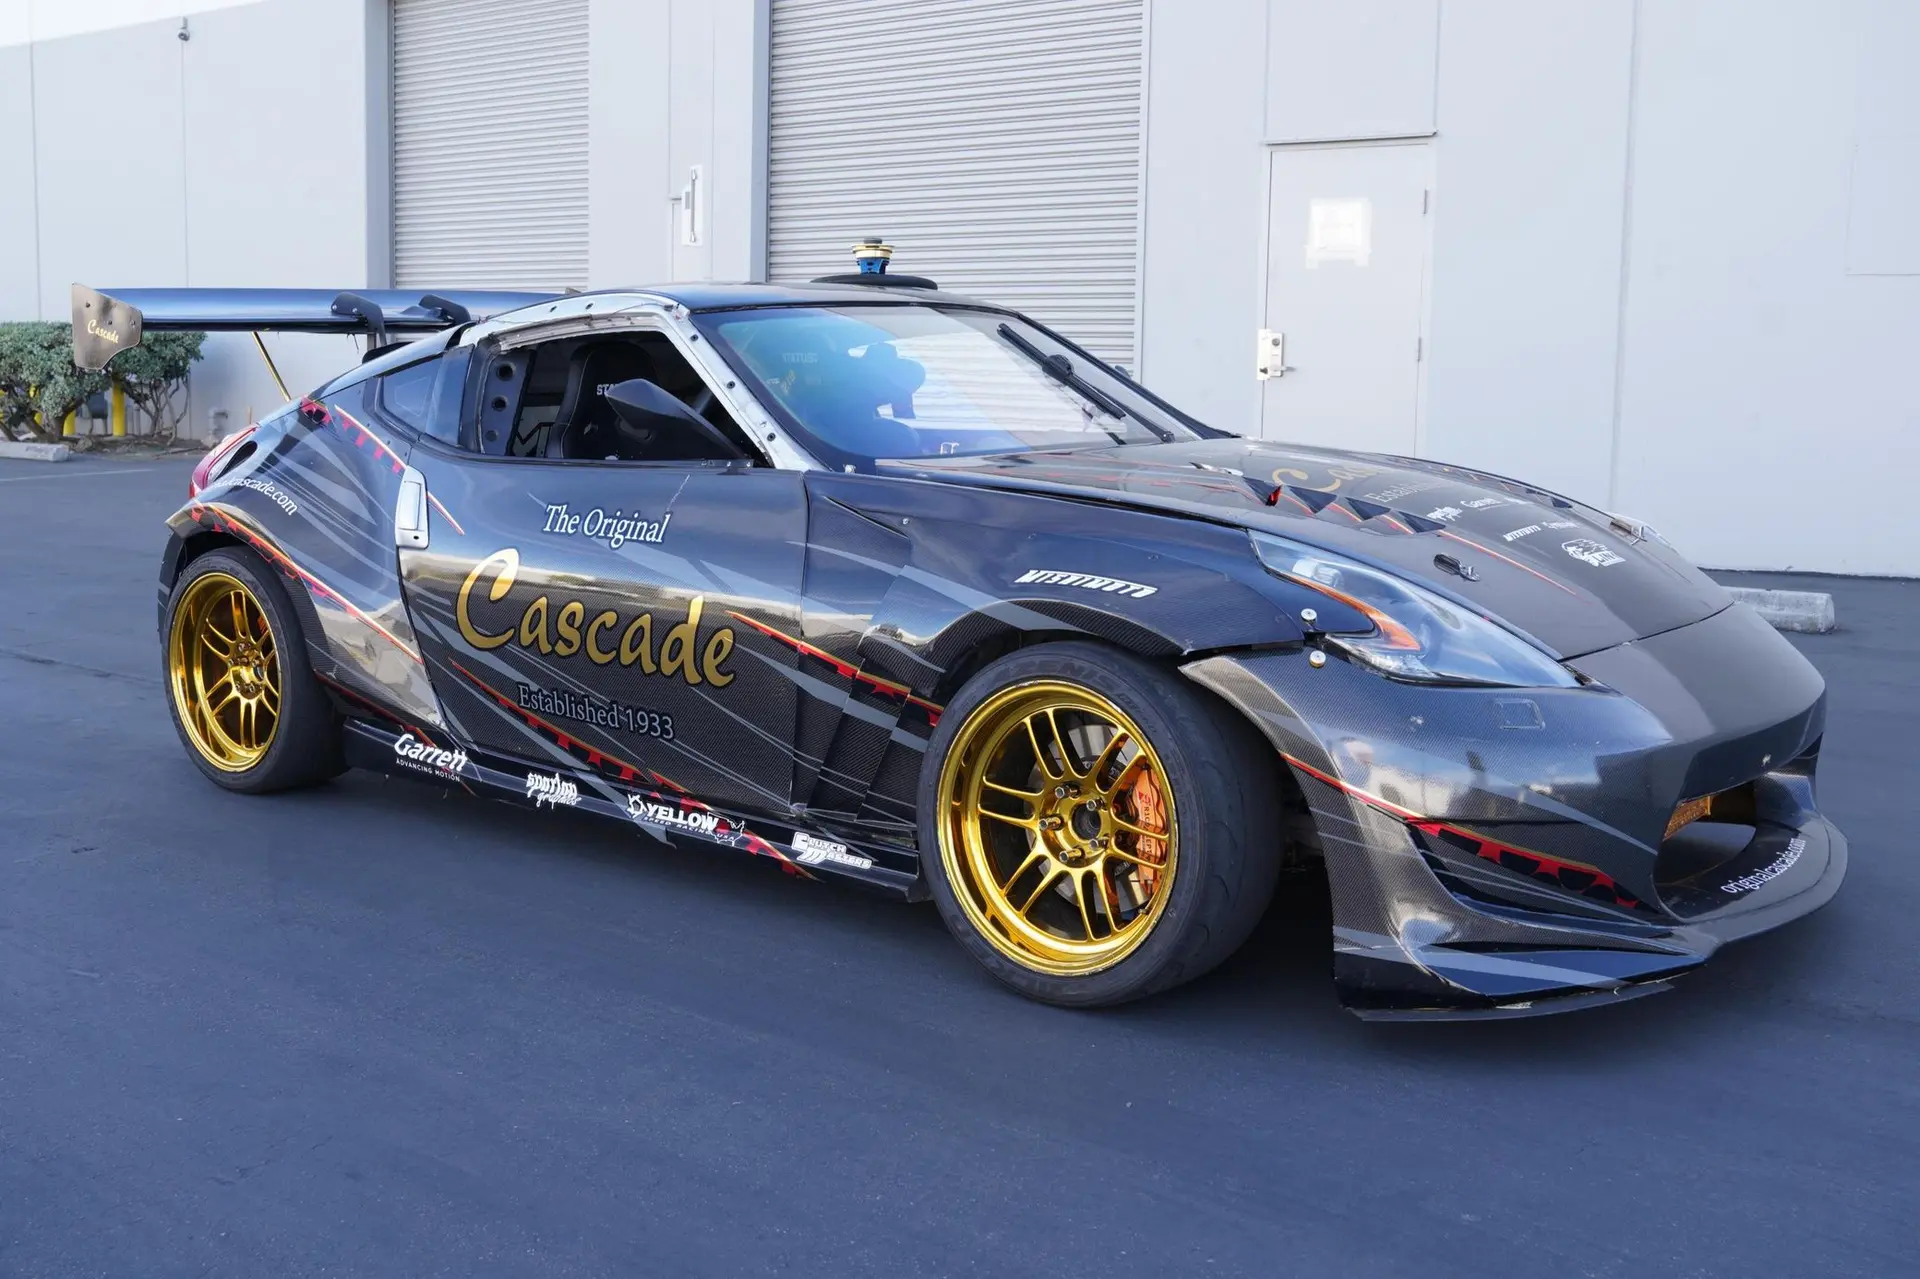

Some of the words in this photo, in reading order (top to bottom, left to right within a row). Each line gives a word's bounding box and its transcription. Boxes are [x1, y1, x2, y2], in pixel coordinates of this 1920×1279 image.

[87, 319, 119, 344] Cascade
[543, 504, 578, 534] The
[583, 508, 671, 548] Original
[456, 548, 734, 687] Cascade
[518, 684, 620, 729] Established
[625, 708, 674, 739] 1933
[394, 733, 467, 772] Garrett
[396, 758, 434, 775] ADVANCING
[435, 769, 461, 783] MOTION
[643, 816, 672, 826] SPEED
[676, 824, 713, 836] RACING
[717, 833, 736, 841] USA
[646, 802, 719, 832] YELLOW
